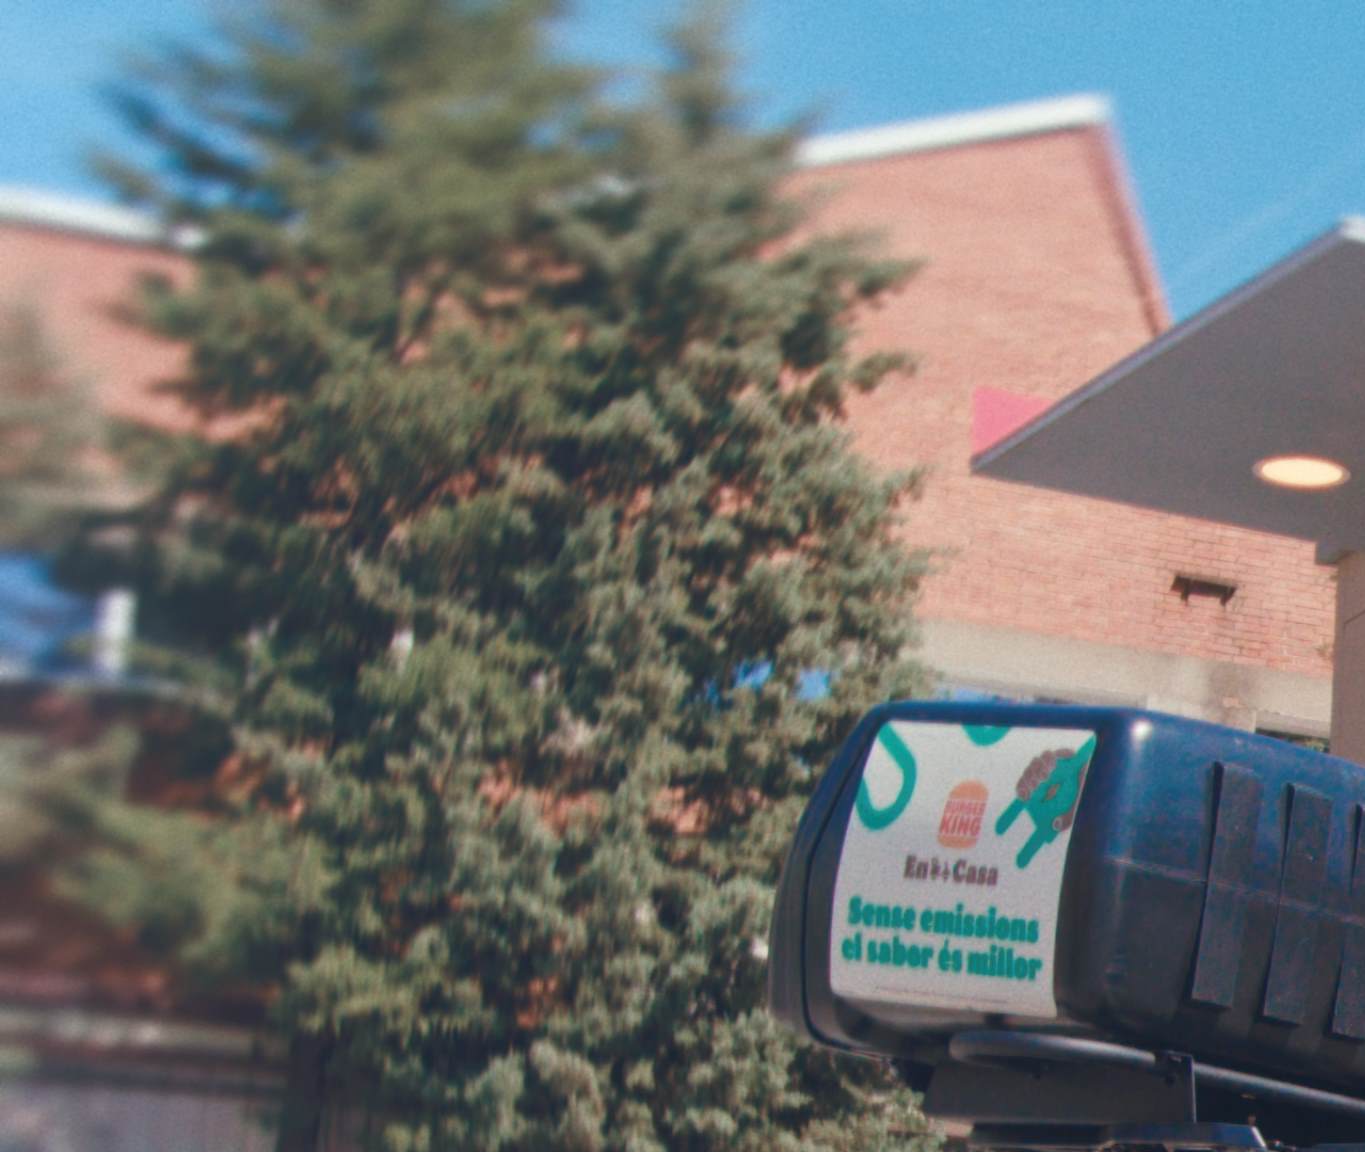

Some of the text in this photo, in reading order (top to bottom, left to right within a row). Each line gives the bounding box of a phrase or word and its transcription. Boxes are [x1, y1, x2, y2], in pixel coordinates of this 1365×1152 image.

[940, 815, 981, 836] KING
[903, 854, 998, 886] En Casa
[848, 894, 1040, 944] Sense emissions
[841, 932, 1043, 981] el sabor és millor
